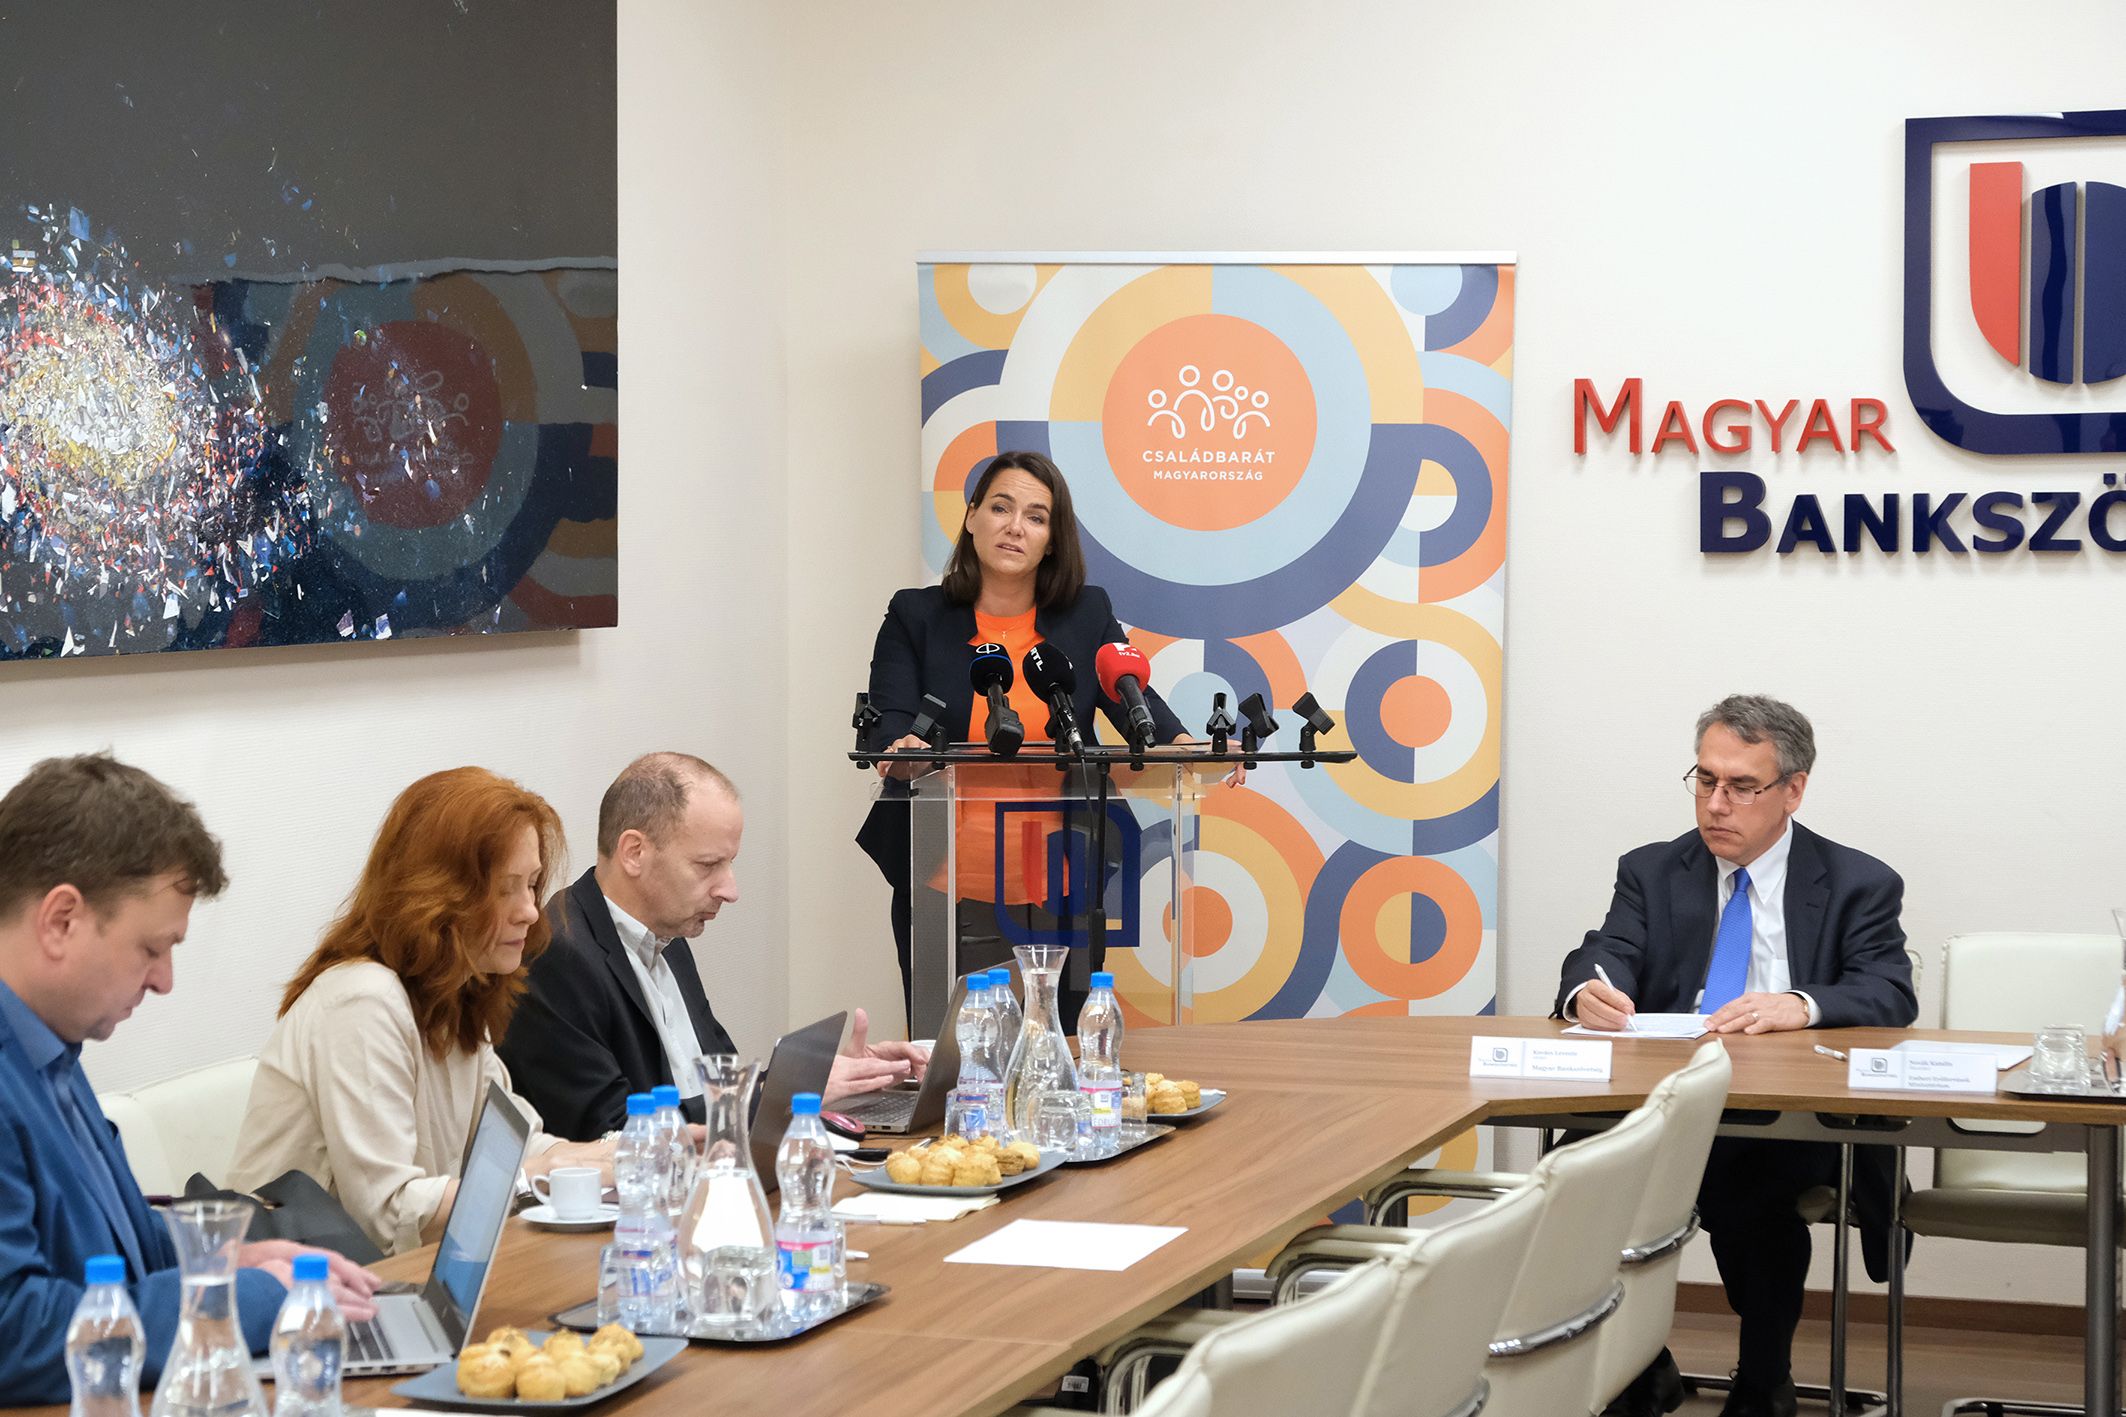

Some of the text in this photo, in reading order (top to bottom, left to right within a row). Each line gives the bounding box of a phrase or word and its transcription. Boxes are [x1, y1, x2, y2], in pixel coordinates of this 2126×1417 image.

[1573, 377, 1896, 455] MAGYAR
[1142, 448, 1275, 463] CSALÁDBARÁT
[1153, 469, 1263, 481] MAGYARORSZÁG
[1030, 647, 1043, 671] RTL
